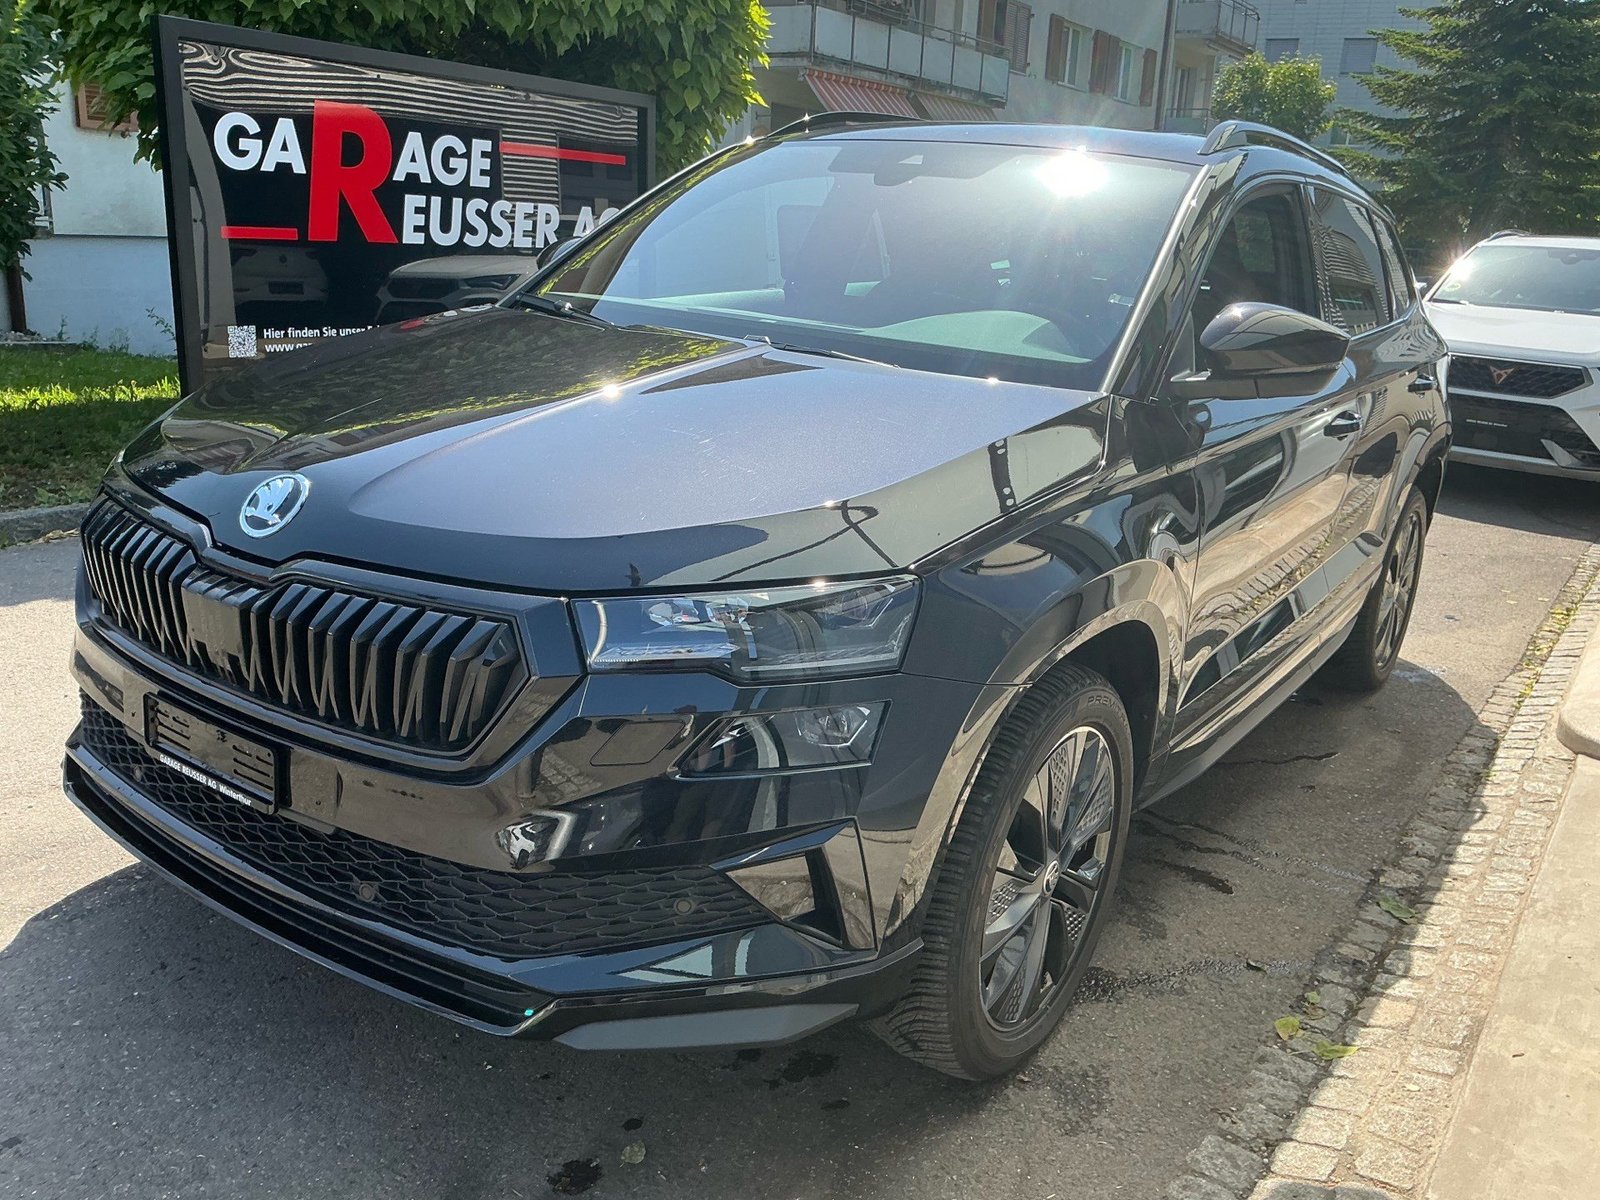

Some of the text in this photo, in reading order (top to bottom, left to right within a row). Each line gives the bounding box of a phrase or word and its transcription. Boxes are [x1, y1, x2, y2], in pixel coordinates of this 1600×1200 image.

[213, 99, 492, 243] GARAGE
[263, 328, 286, 339] Hier
[287, 326, 321, 338] finden
[322, 326, 338, 337] Sie
[160, 754, 252, 806] GARAGE REUSSER AG Winterthur
